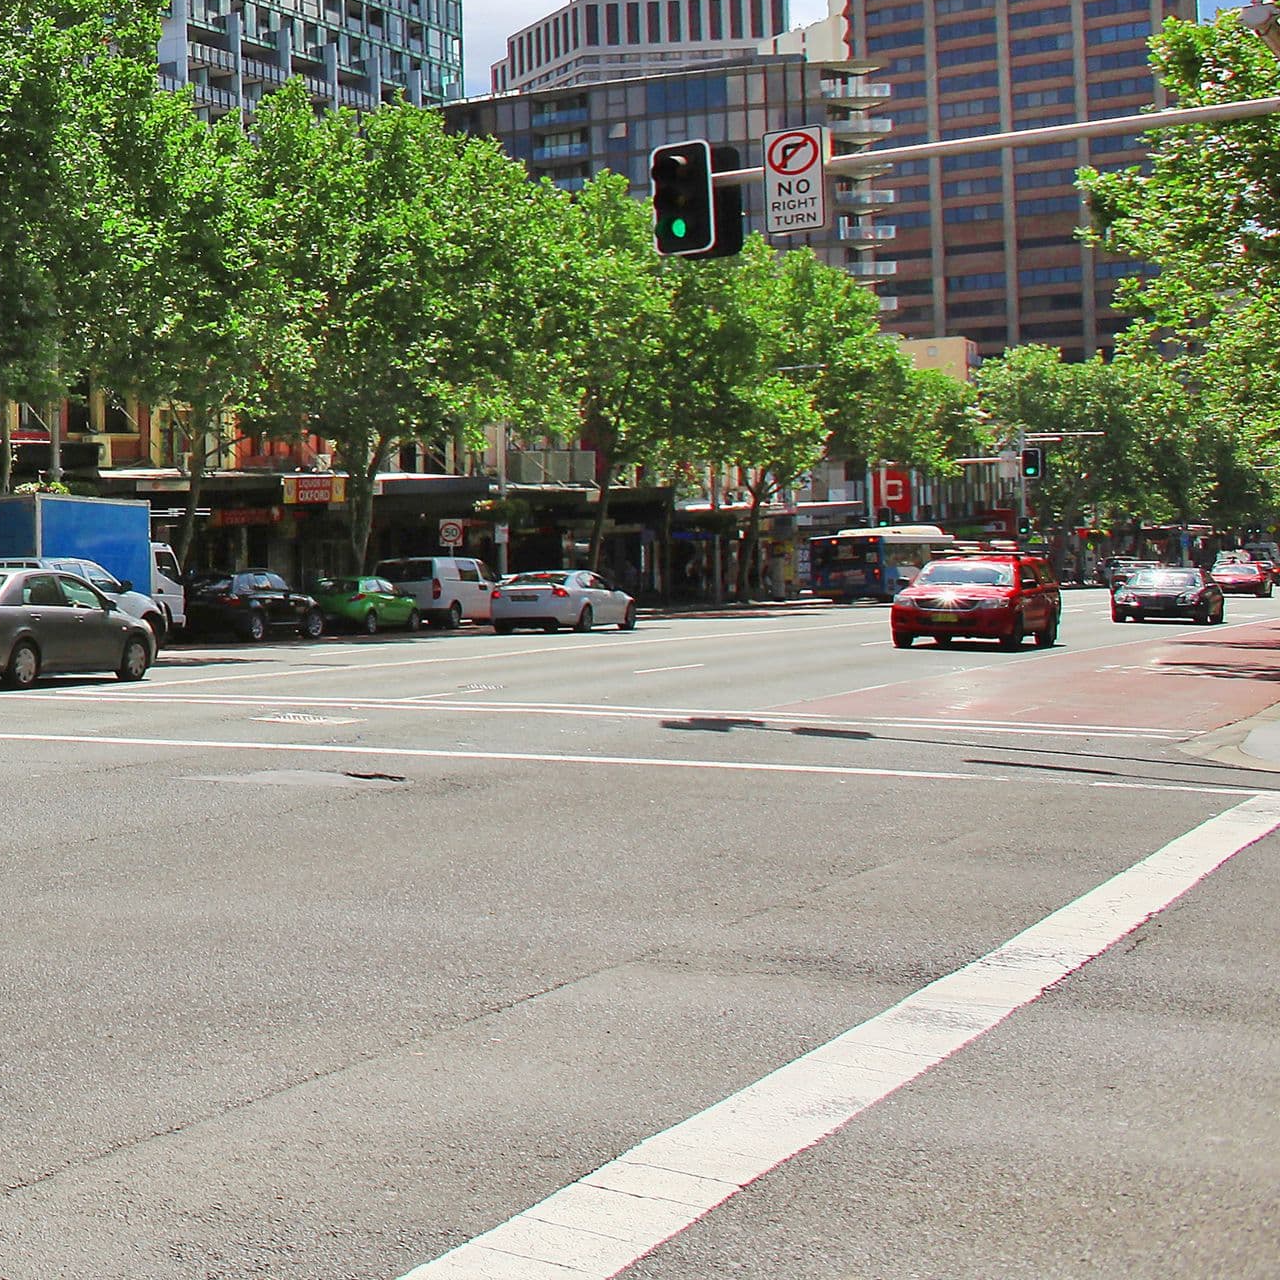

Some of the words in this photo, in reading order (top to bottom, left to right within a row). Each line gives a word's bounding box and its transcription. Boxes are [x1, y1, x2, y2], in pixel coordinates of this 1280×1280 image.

[778, 179, 810, 197] NO
[771, 197, 818, 212] RIGHT
[774, 211, 817, 226] TURN
[298, 489, 330, 501] OXFORD
[443, 527, 458, 538] 50
